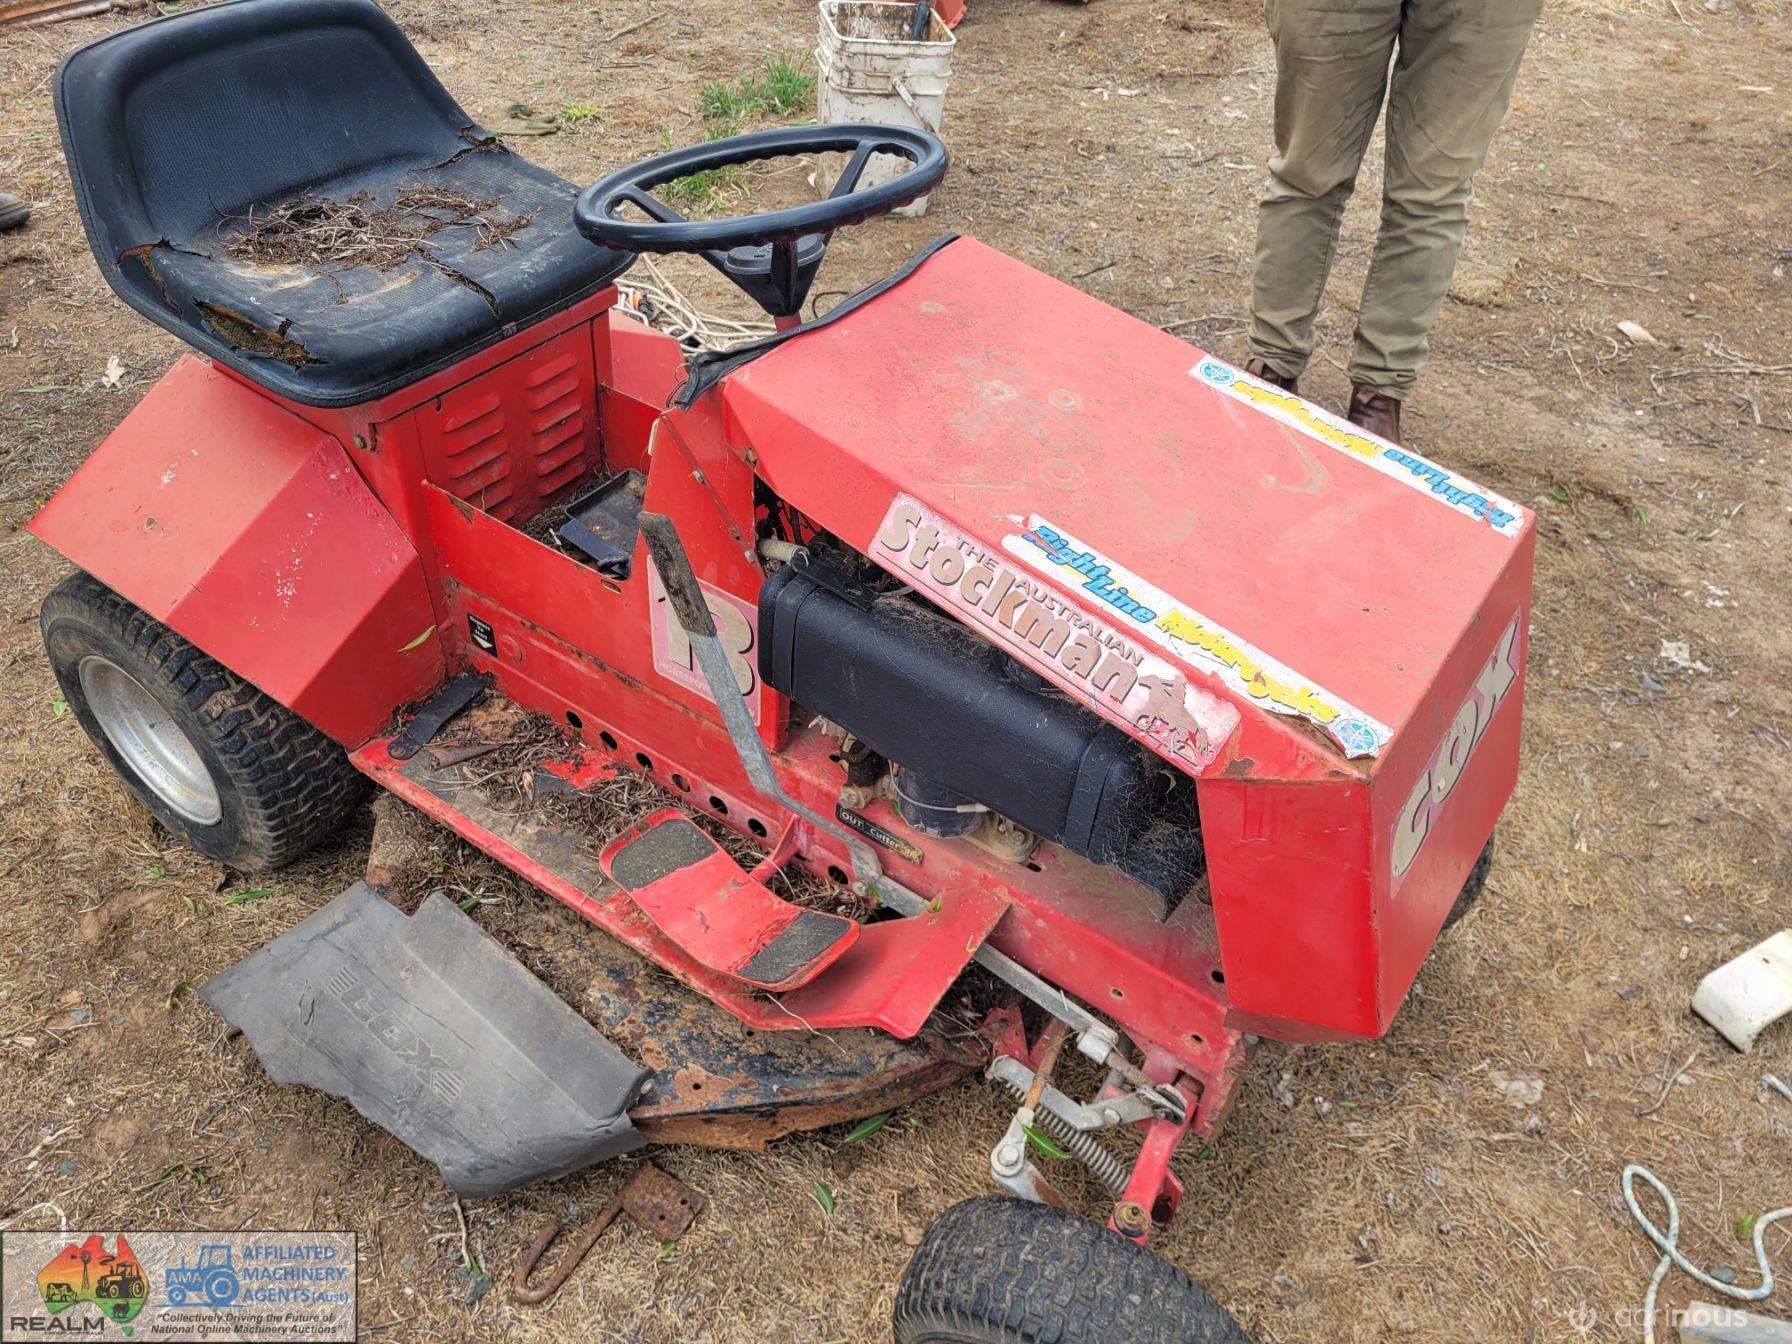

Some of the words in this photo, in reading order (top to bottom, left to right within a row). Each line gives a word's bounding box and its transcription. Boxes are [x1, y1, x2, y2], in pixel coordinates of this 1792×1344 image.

[957, 536, 1000, 573] THE
[880, 504, 1138, 704] Stockman
[1015, 578, 1144, 667] AUSTRALIAN
[1391, 618, 1518, 878] COX
[841, 811, 864, 827] OUT
[870, 827, 902, 850] Cutter
[339, 986, 451, 1088] COX
